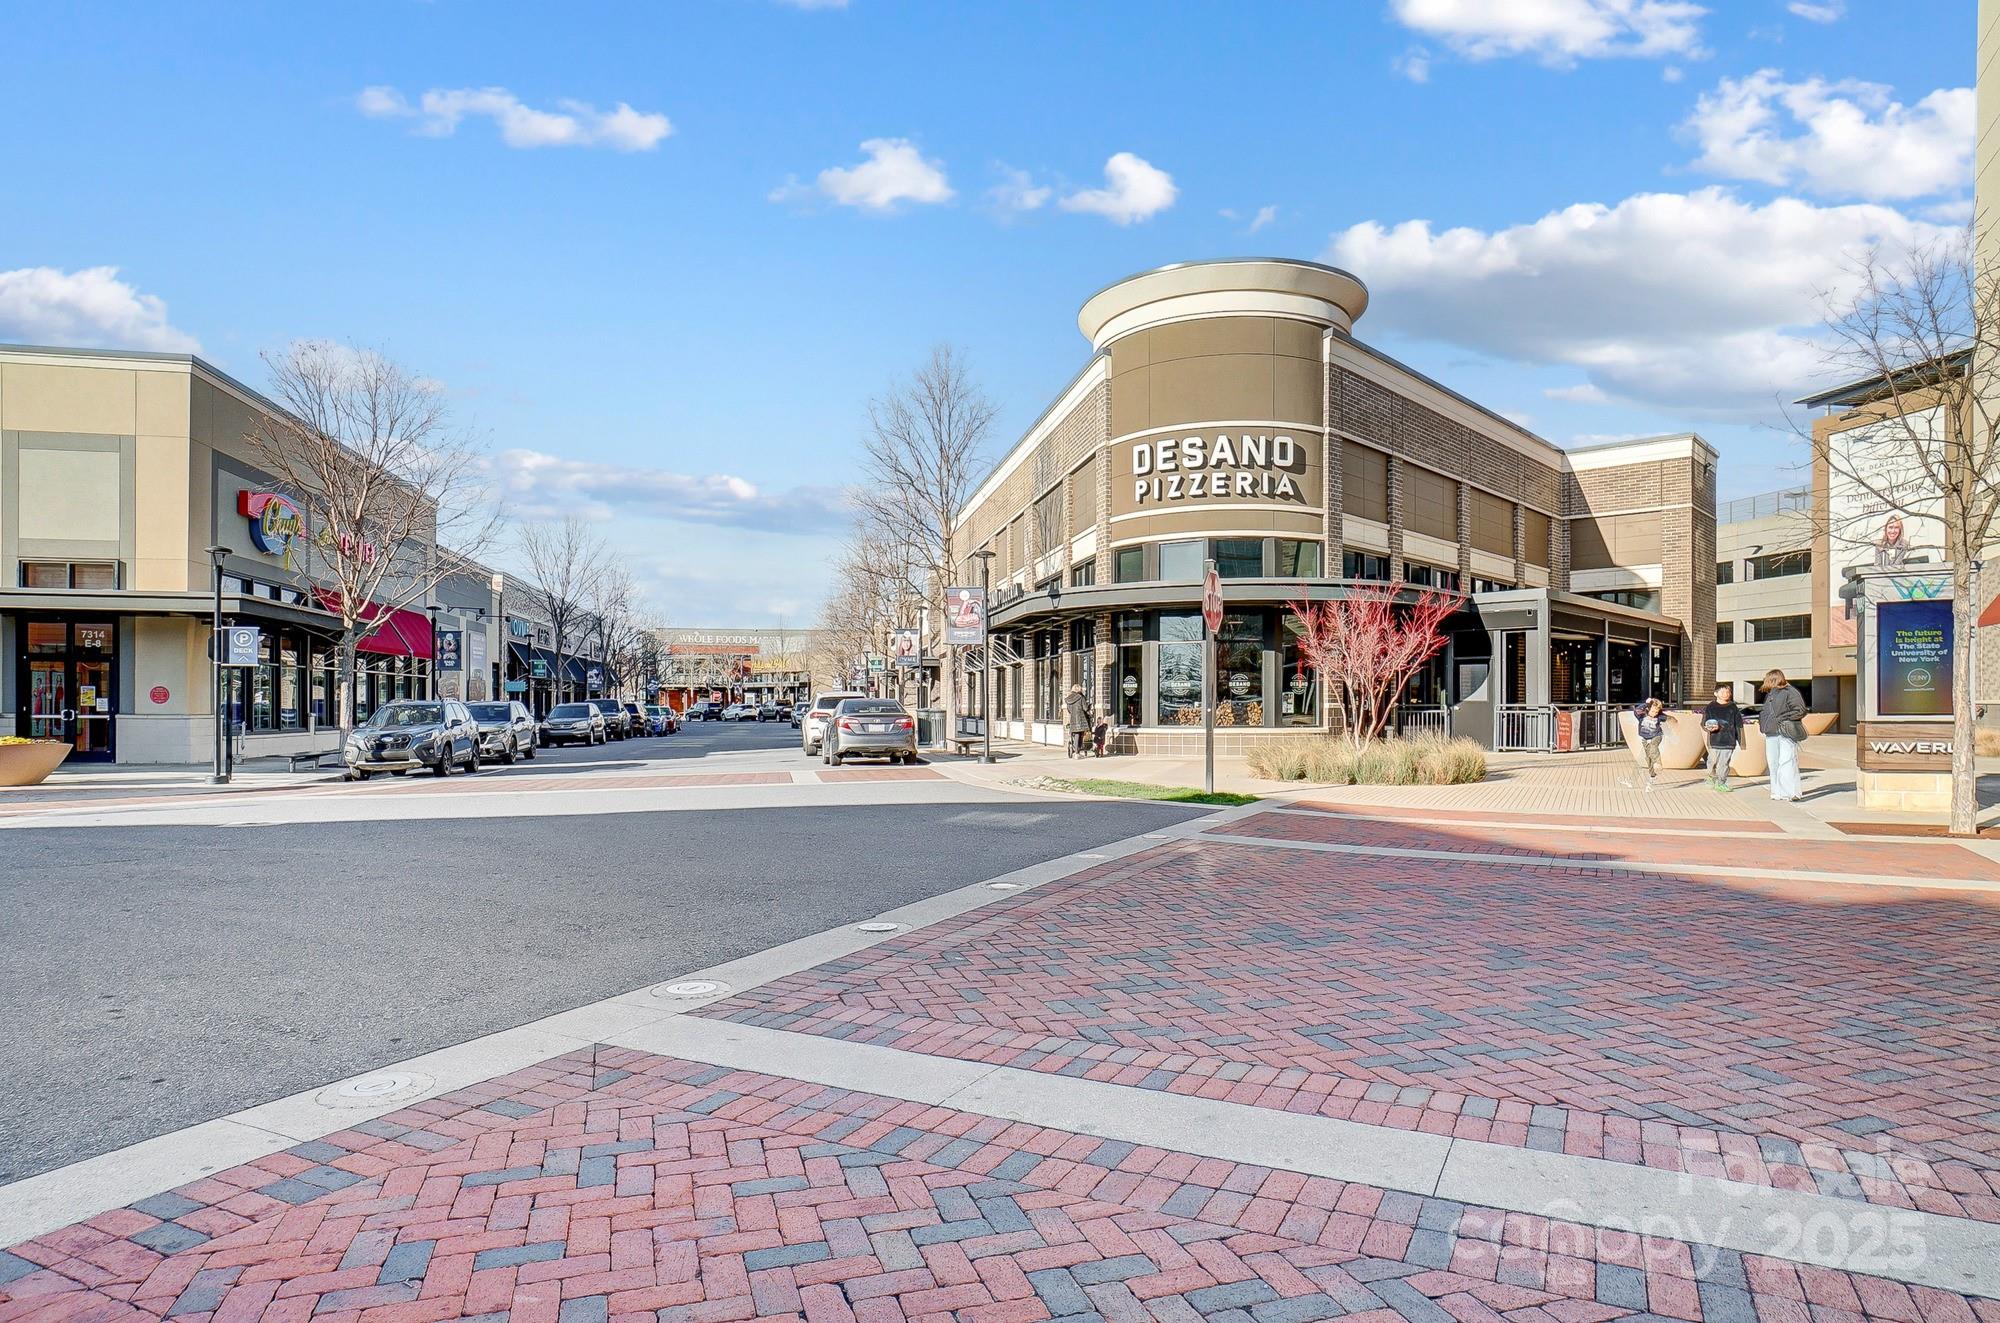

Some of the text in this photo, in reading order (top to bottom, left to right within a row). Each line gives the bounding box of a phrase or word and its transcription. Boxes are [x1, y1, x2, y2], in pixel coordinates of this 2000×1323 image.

[1132, 435, 1294, 475] DESANO
[1135, 471, 1295, 502] PIZZERIA
[1204, 590, 1222, 612] STOP
[81, 630, 105, 638] 7314
[240, 633, 249, 643] P
[716, 635, 746, 644] FOODS
[84, 639, 101, 647] E-8
[1870, 742, 1954, 754] WAVERL
